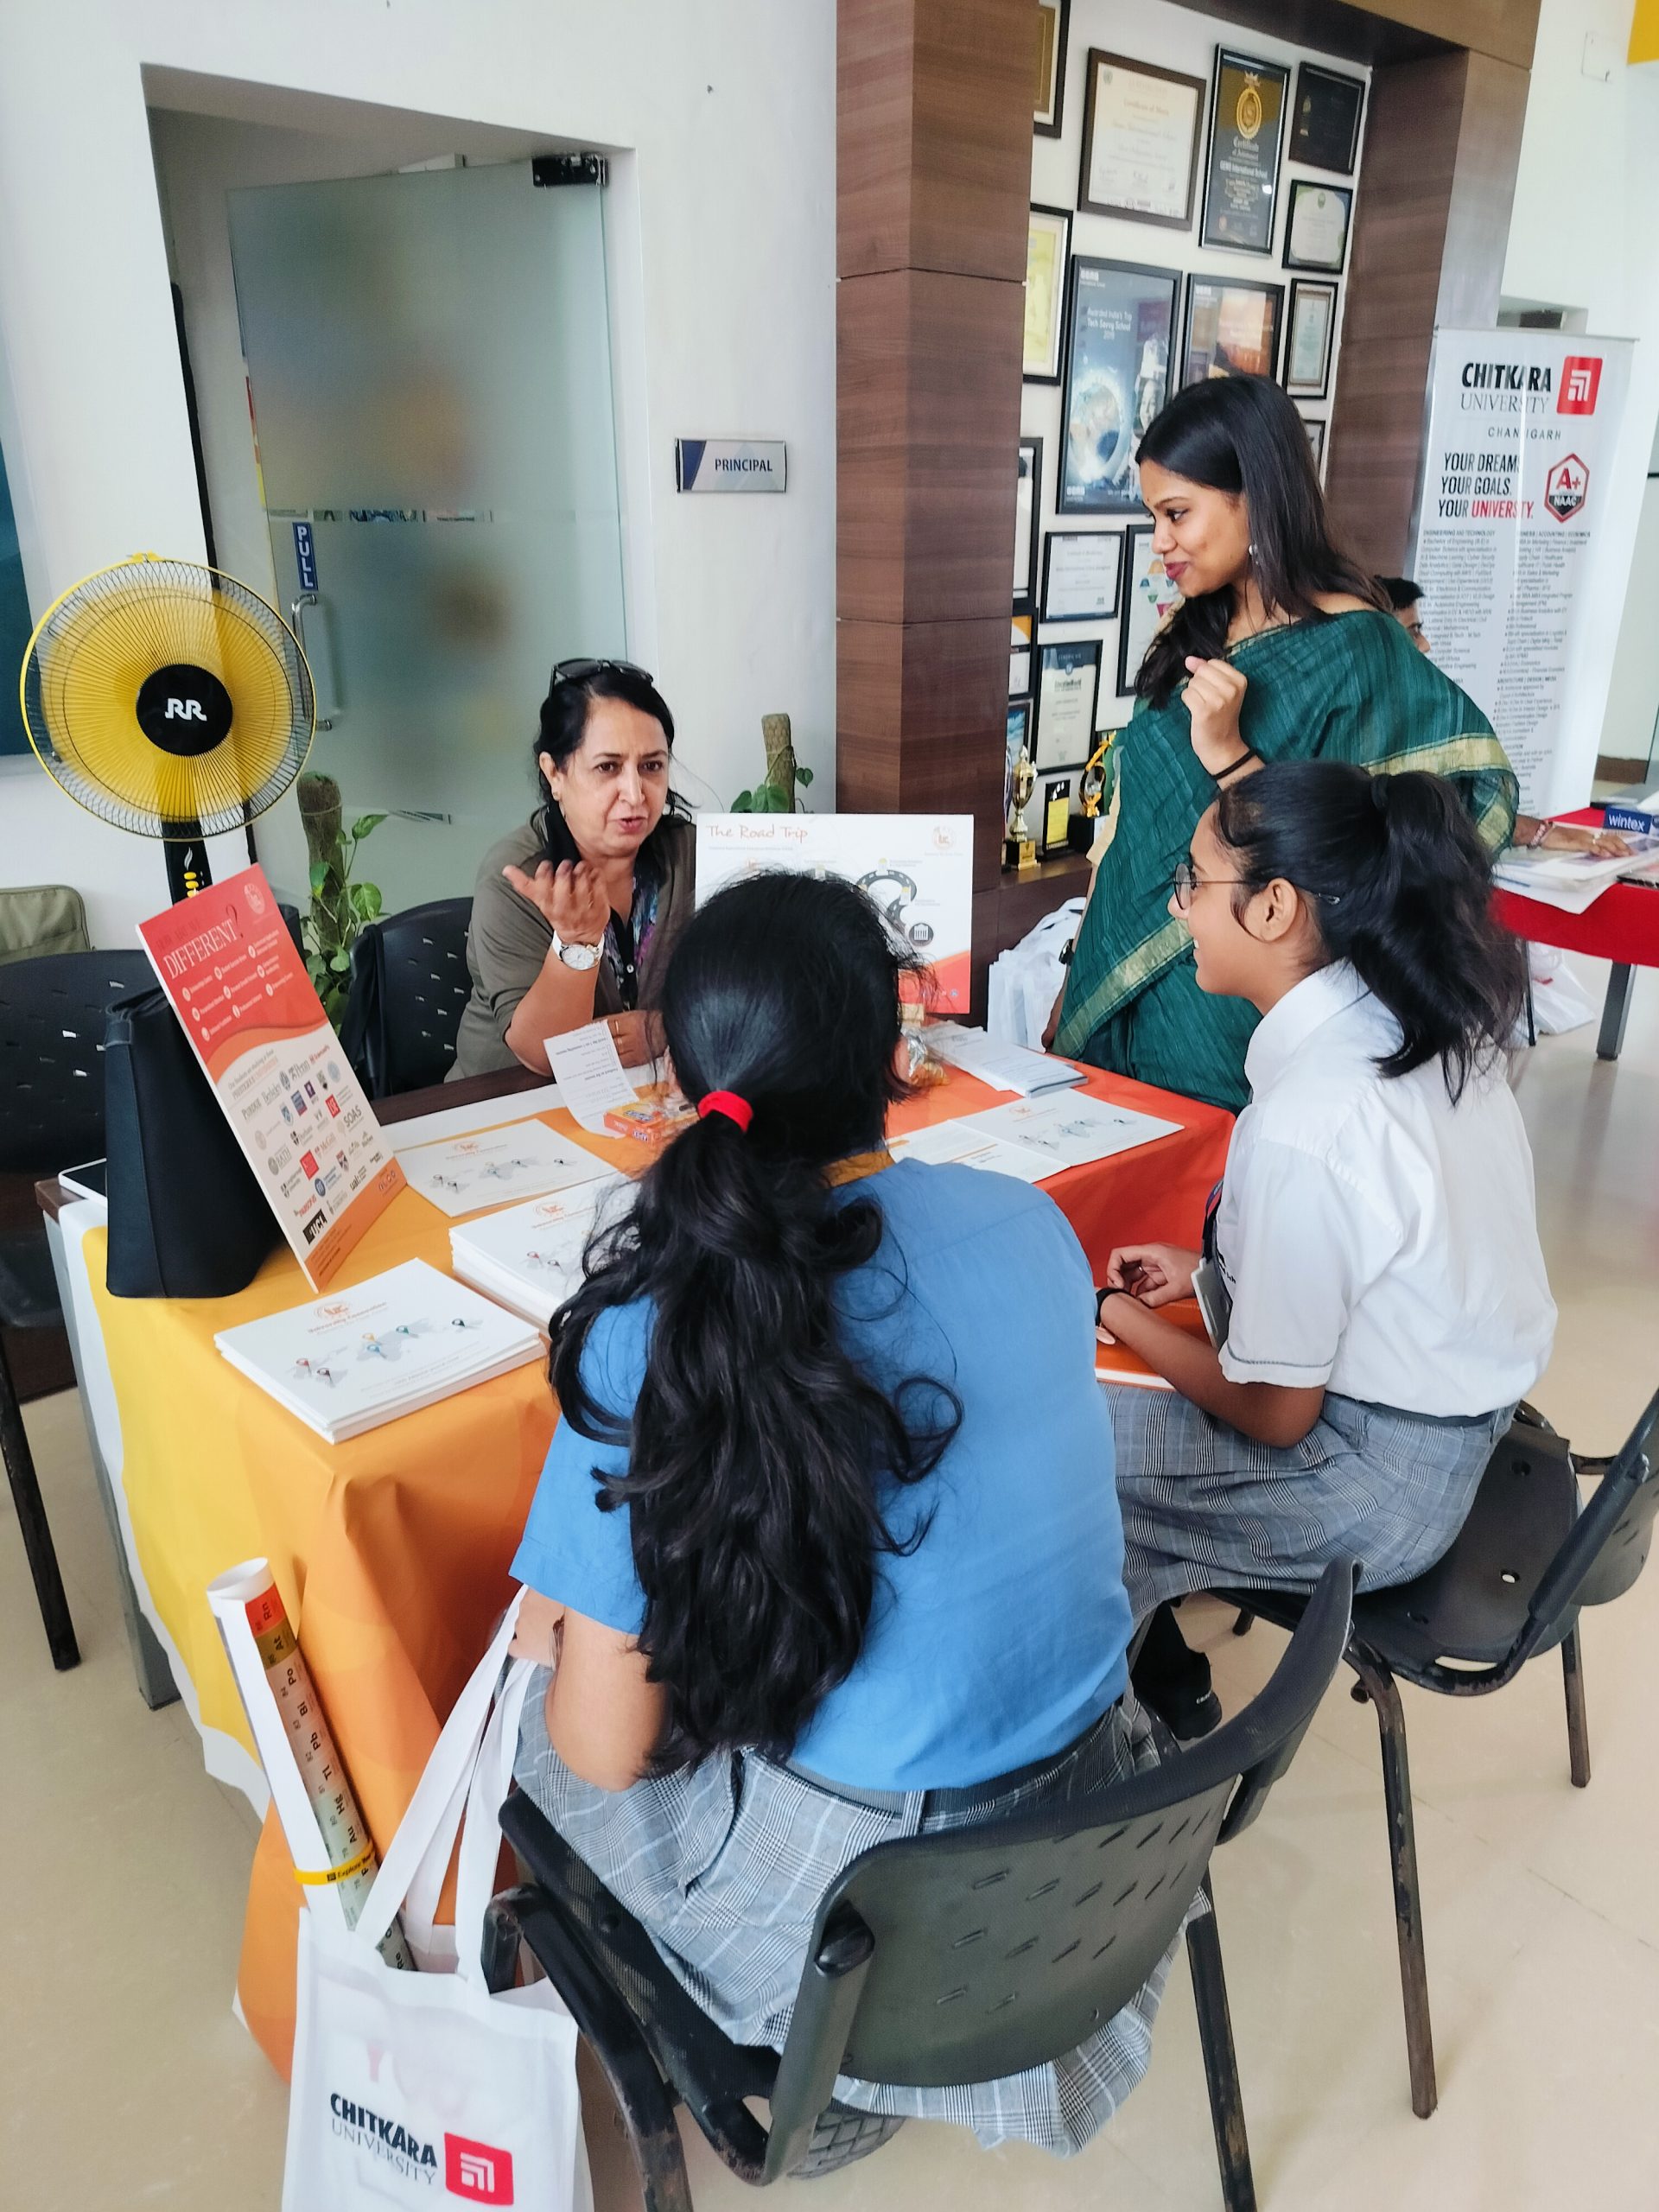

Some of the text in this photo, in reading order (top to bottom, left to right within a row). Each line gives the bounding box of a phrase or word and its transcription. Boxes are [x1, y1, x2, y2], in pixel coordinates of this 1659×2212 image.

[1462, 362, 1551, 392] CHITKARA
[1488, 427, 1561, 441] CHANIGARH
[715, 459, 773, 472] PRINCIPAL
[1444, 452, 1475, 472] YOUR
[1441, 476, 1512, 496] YOUR GOALS.
[1555, 467, 1581, 490] A+
[1439, 499, 1534, 519] YOUR UNIVERSTY.
[297, 526, 314, 588] PULL
[165, 698, 207, 721] RR
[1608, 813, 1645, 832] wintex
[706, 823, 809, 844] The Road Trip
[343, 1104, 362, 1128] SOAS
[262, 1601, 272, 1621] Rn
[273, 1634, 284, 1651] At
[287, 1668, 297, 1687] Po
[296, 1700, 308, 1717] Bi
[310, 1732, 321, 1751] Pb
[321, 1764, 333, 1781] Tl
[334, 1794, 346, 1815] Hg
[347, 1826, 358, 1844] Au
[396, 1951, 404, 1970] Re
[330, 2093, 438, 2168] CHITKARA
[332, 2118, 436, 2185] UNIVERSITY
